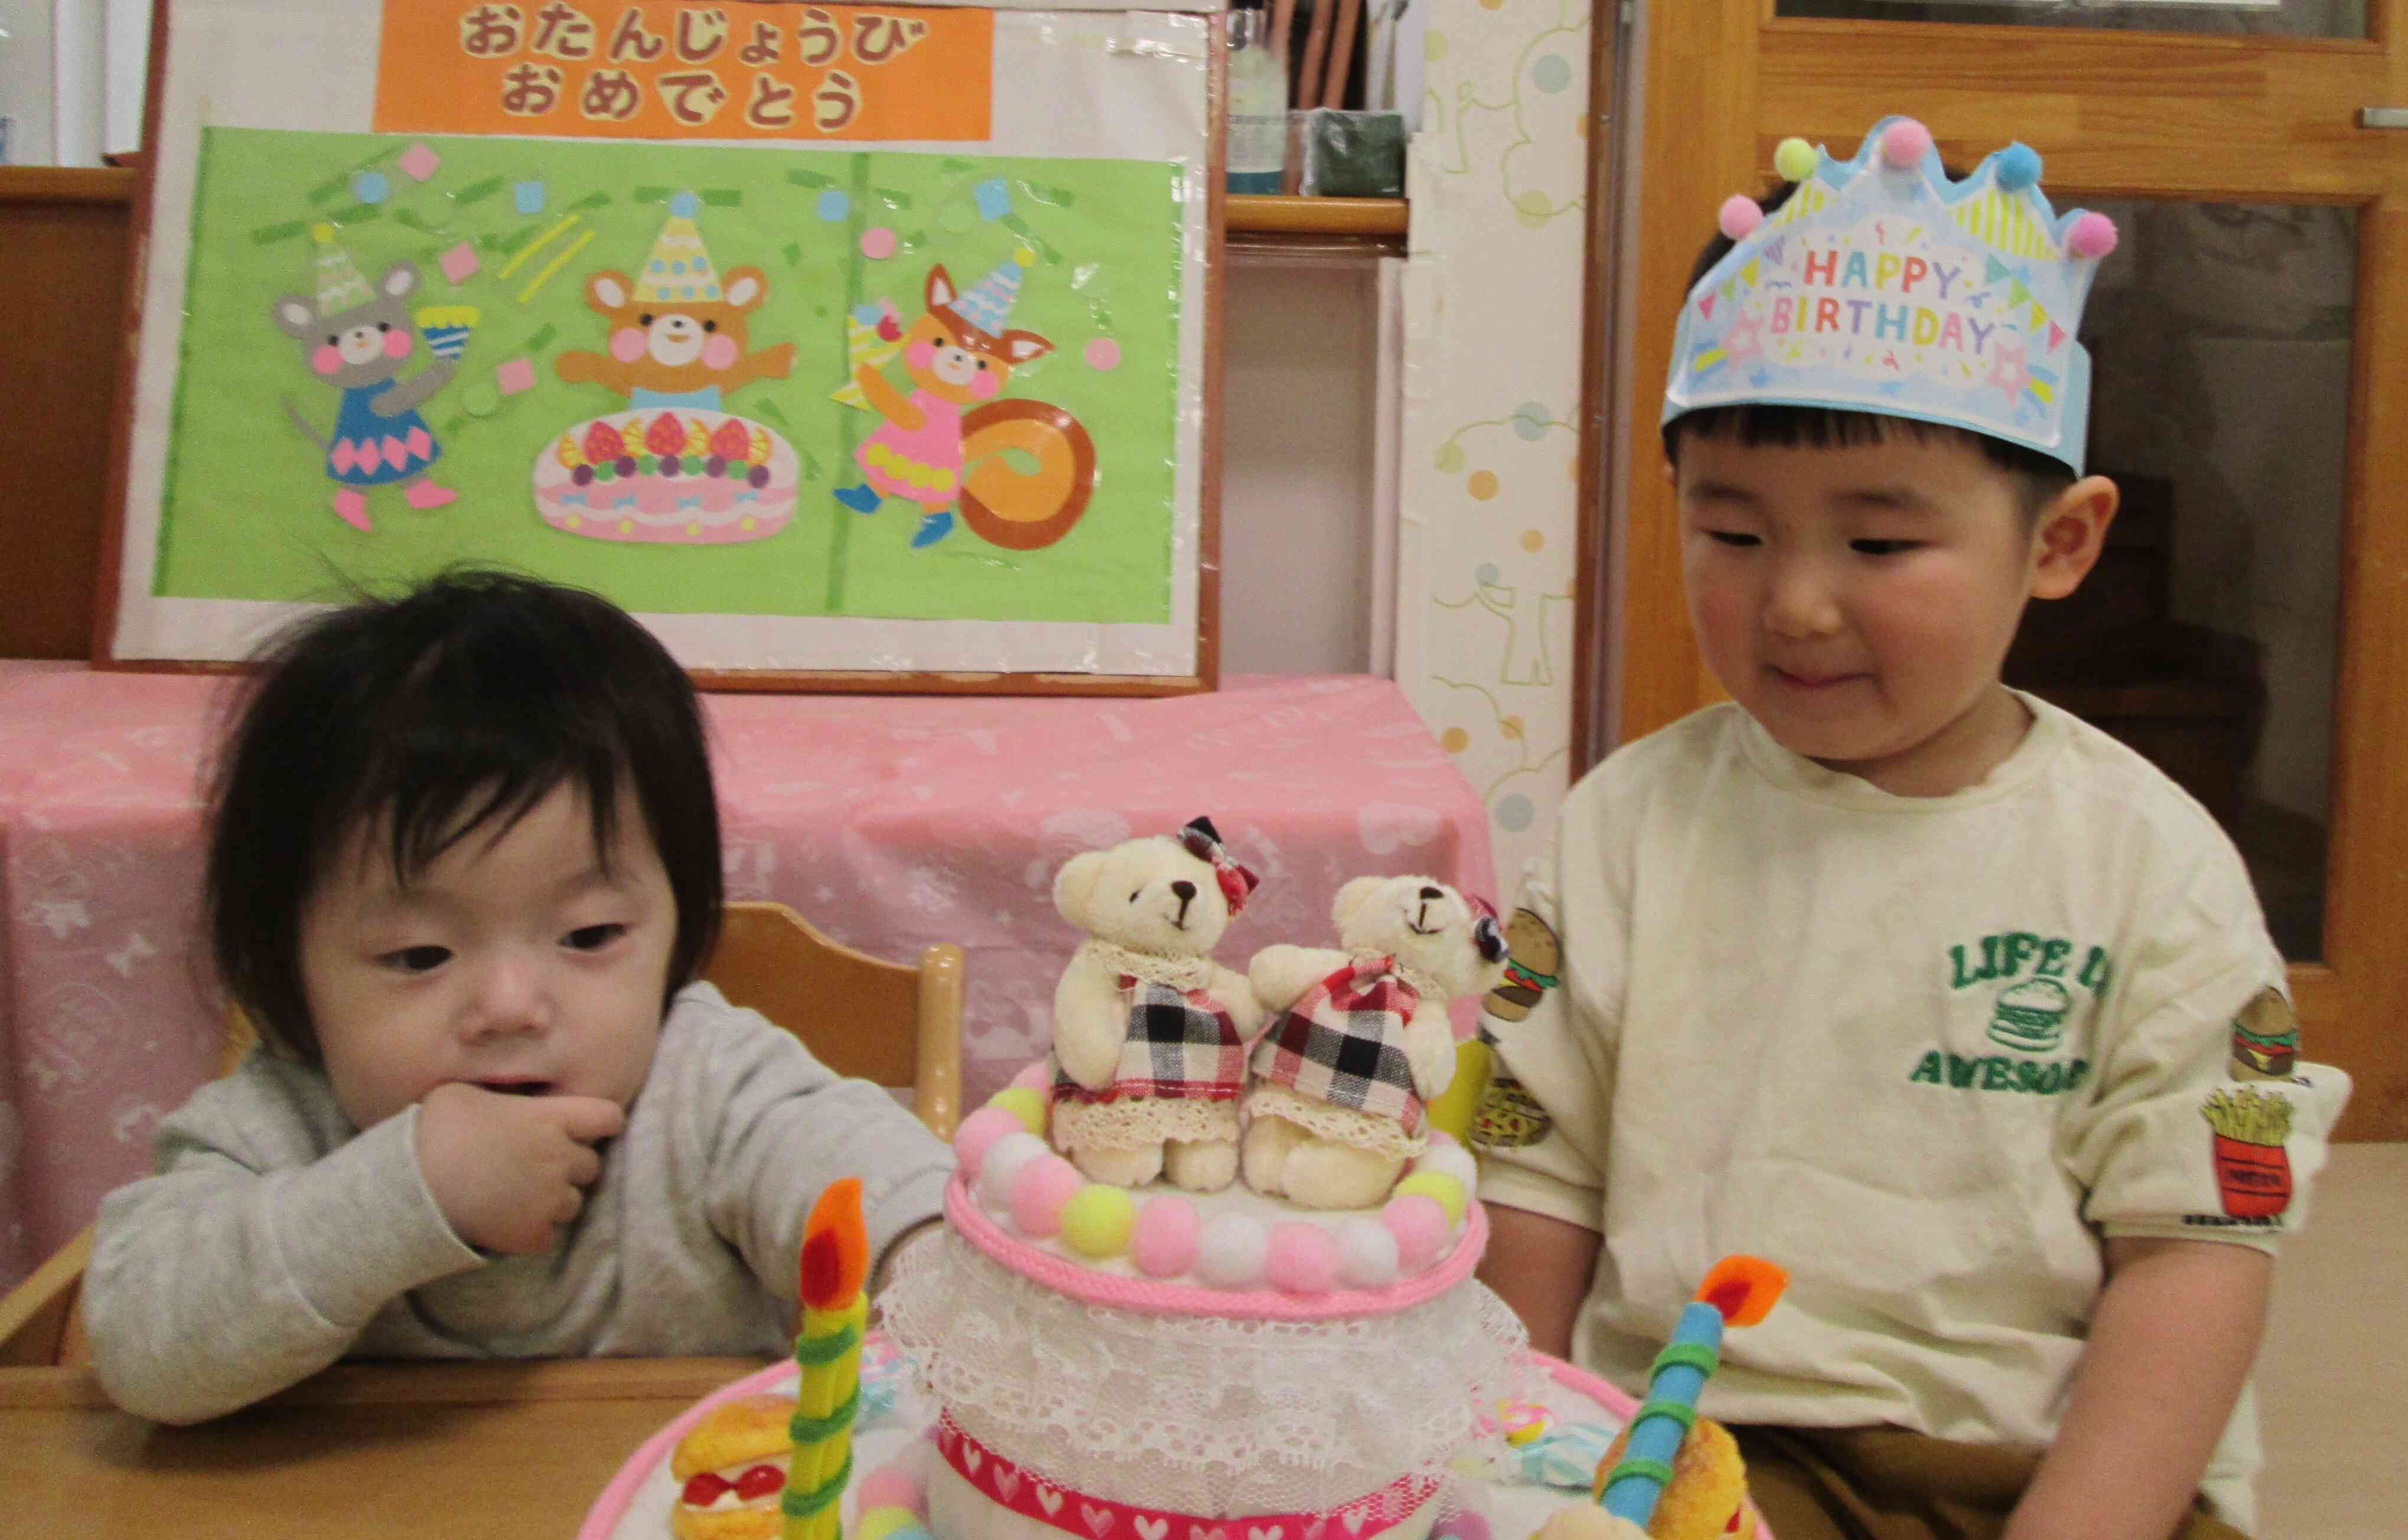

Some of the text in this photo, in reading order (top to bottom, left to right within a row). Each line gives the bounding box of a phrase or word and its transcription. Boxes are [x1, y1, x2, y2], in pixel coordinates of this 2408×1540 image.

[464, 2, 926, 64] おたんじょうび
[502, 63, 856, 129] おめでとう
[1803, 249, 1963, 299] HAPPY
[1770, 295, 1995, 354] BIRTHDAY
[1949, 931, 2072, 990] LIFE
